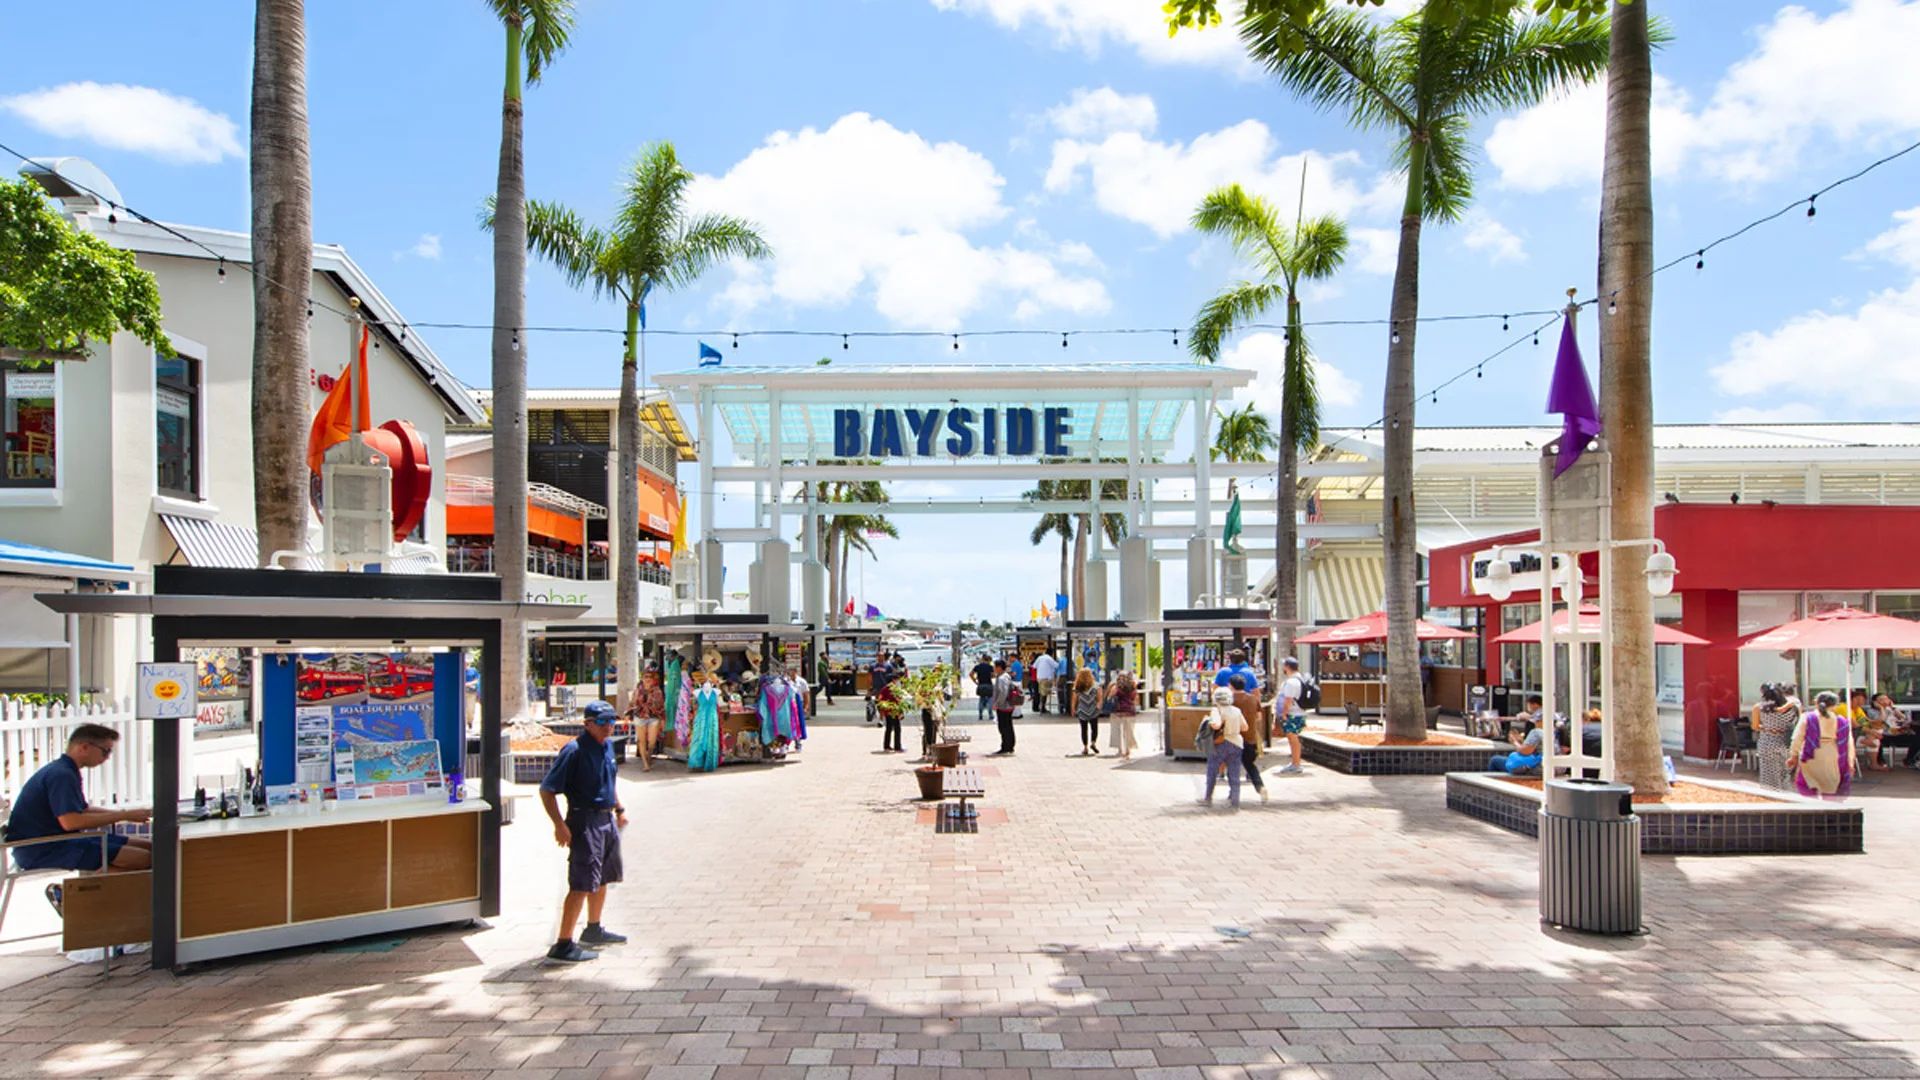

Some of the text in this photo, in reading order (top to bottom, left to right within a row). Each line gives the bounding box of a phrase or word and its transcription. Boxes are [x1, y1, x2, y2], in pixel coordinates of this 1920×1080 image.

[833, 407, 1073, 457] BAYSIDE
[339, 705, 364, 714] BOAT
[367, 705, 391, 713] TOUR
[393, 703, 433, 712] TICKETS
